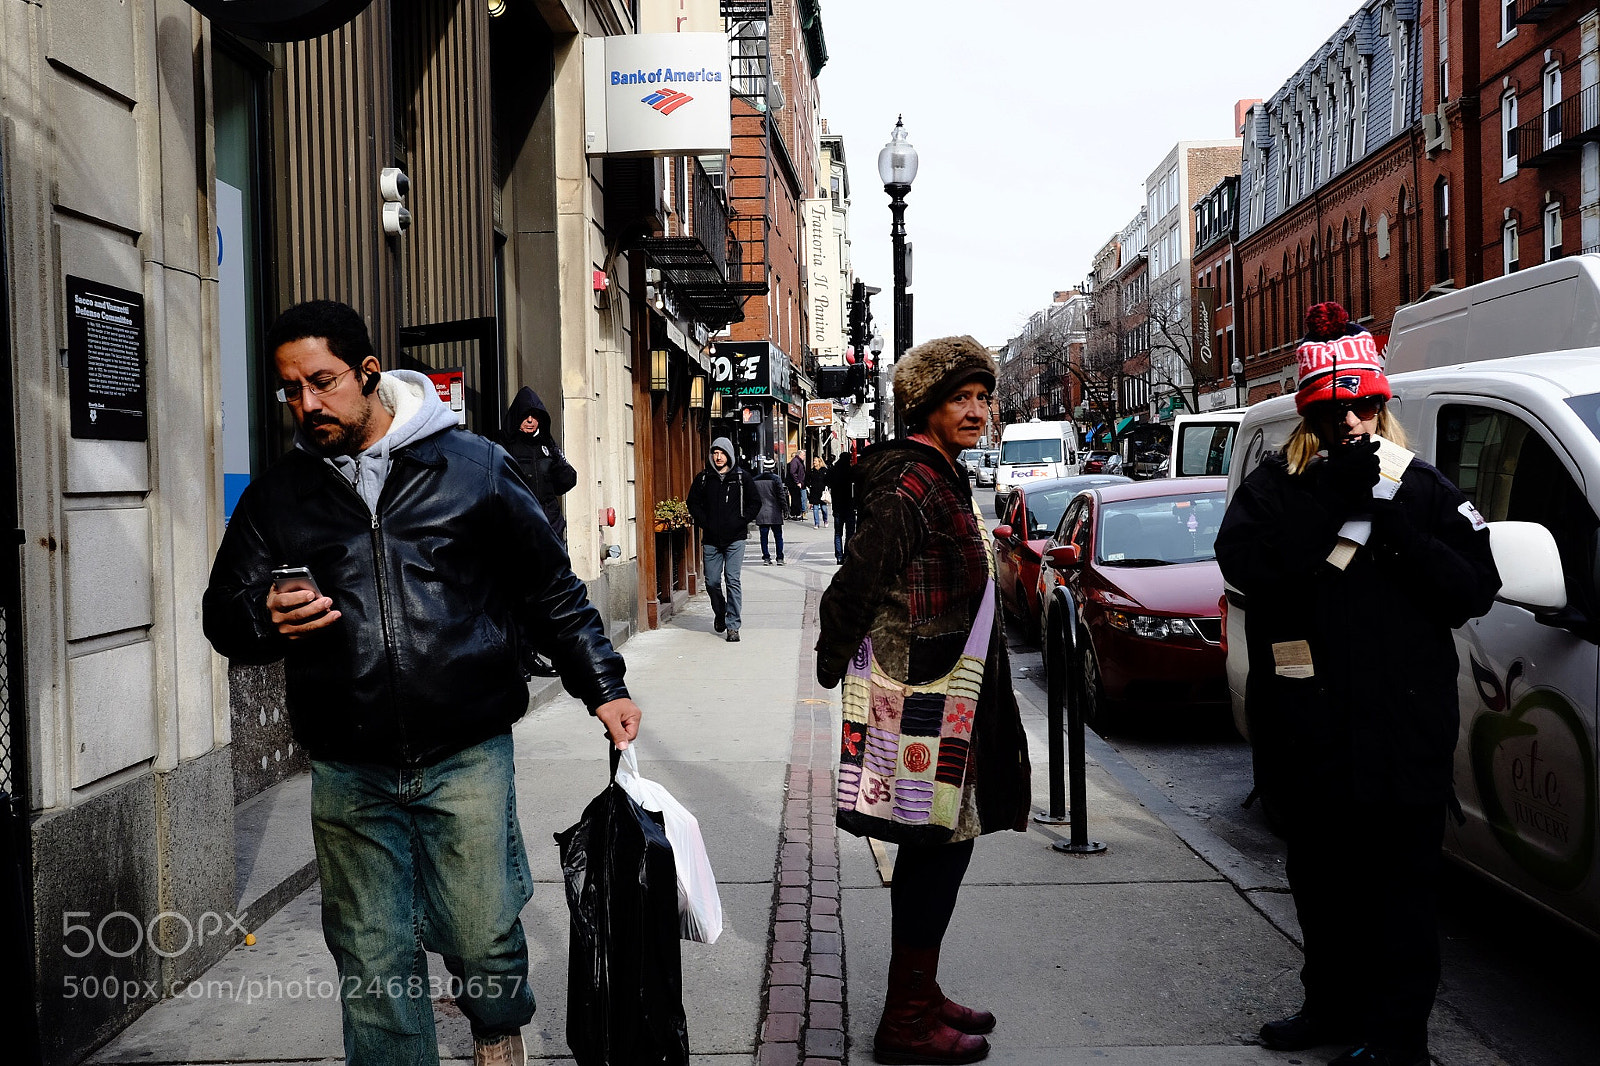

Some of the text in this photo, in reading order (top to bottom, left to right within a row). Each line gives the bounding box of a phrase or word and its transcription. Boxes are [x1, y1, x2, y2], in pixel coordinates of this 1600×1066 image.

[611, 68, 722, 85] Bank of America
[812, 204, 827, 267] Trattoria
[75, 294, 93, 306] Sacco
[814, 295, 830, 342] Panino
[1011, 469, 1048, 478] FedEx
[1512, 800, 1570, 843] JUICERY
